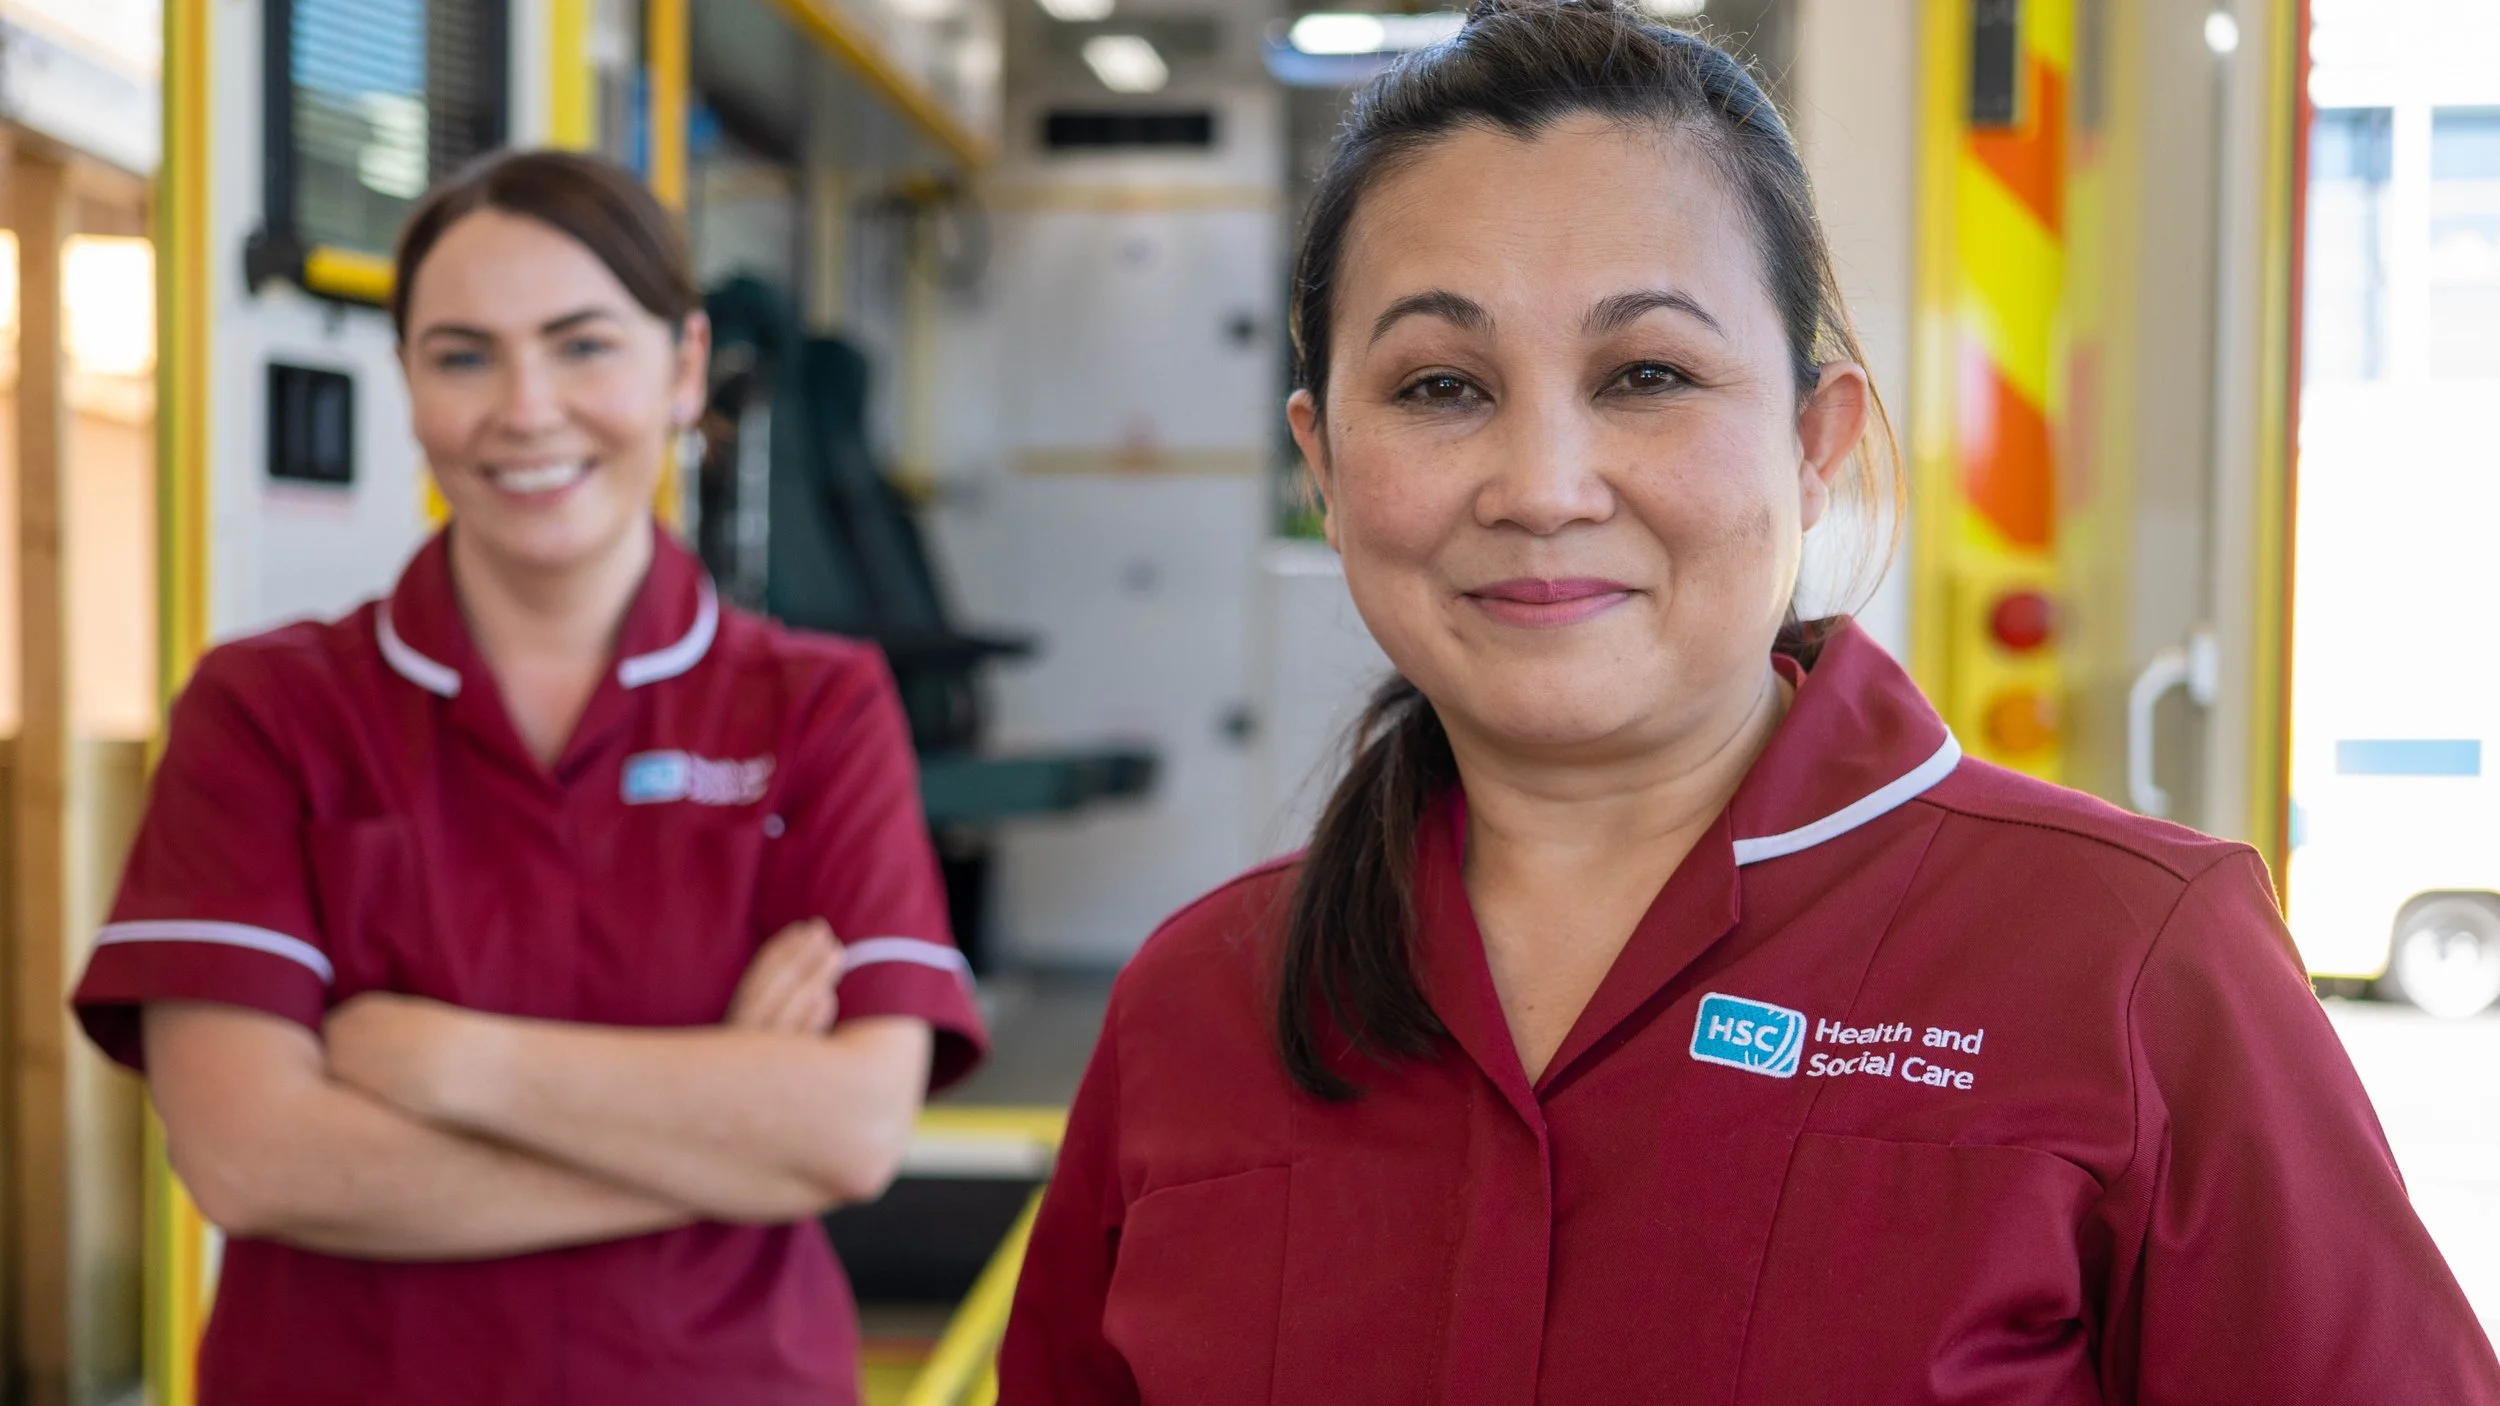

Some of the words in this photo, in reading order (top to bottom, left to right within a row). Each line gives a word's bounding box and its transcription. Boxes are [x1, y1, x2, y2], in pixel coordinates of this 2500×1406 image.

[1707, 1015, 1779, 1052] HSC
[1814, 1017, 1912, 1045] Health
[1922, 1026, 1984, 1055] and
[1806, 1051, 1895, 1078] Social
[1901, 1056, 1974, 1090] Care
